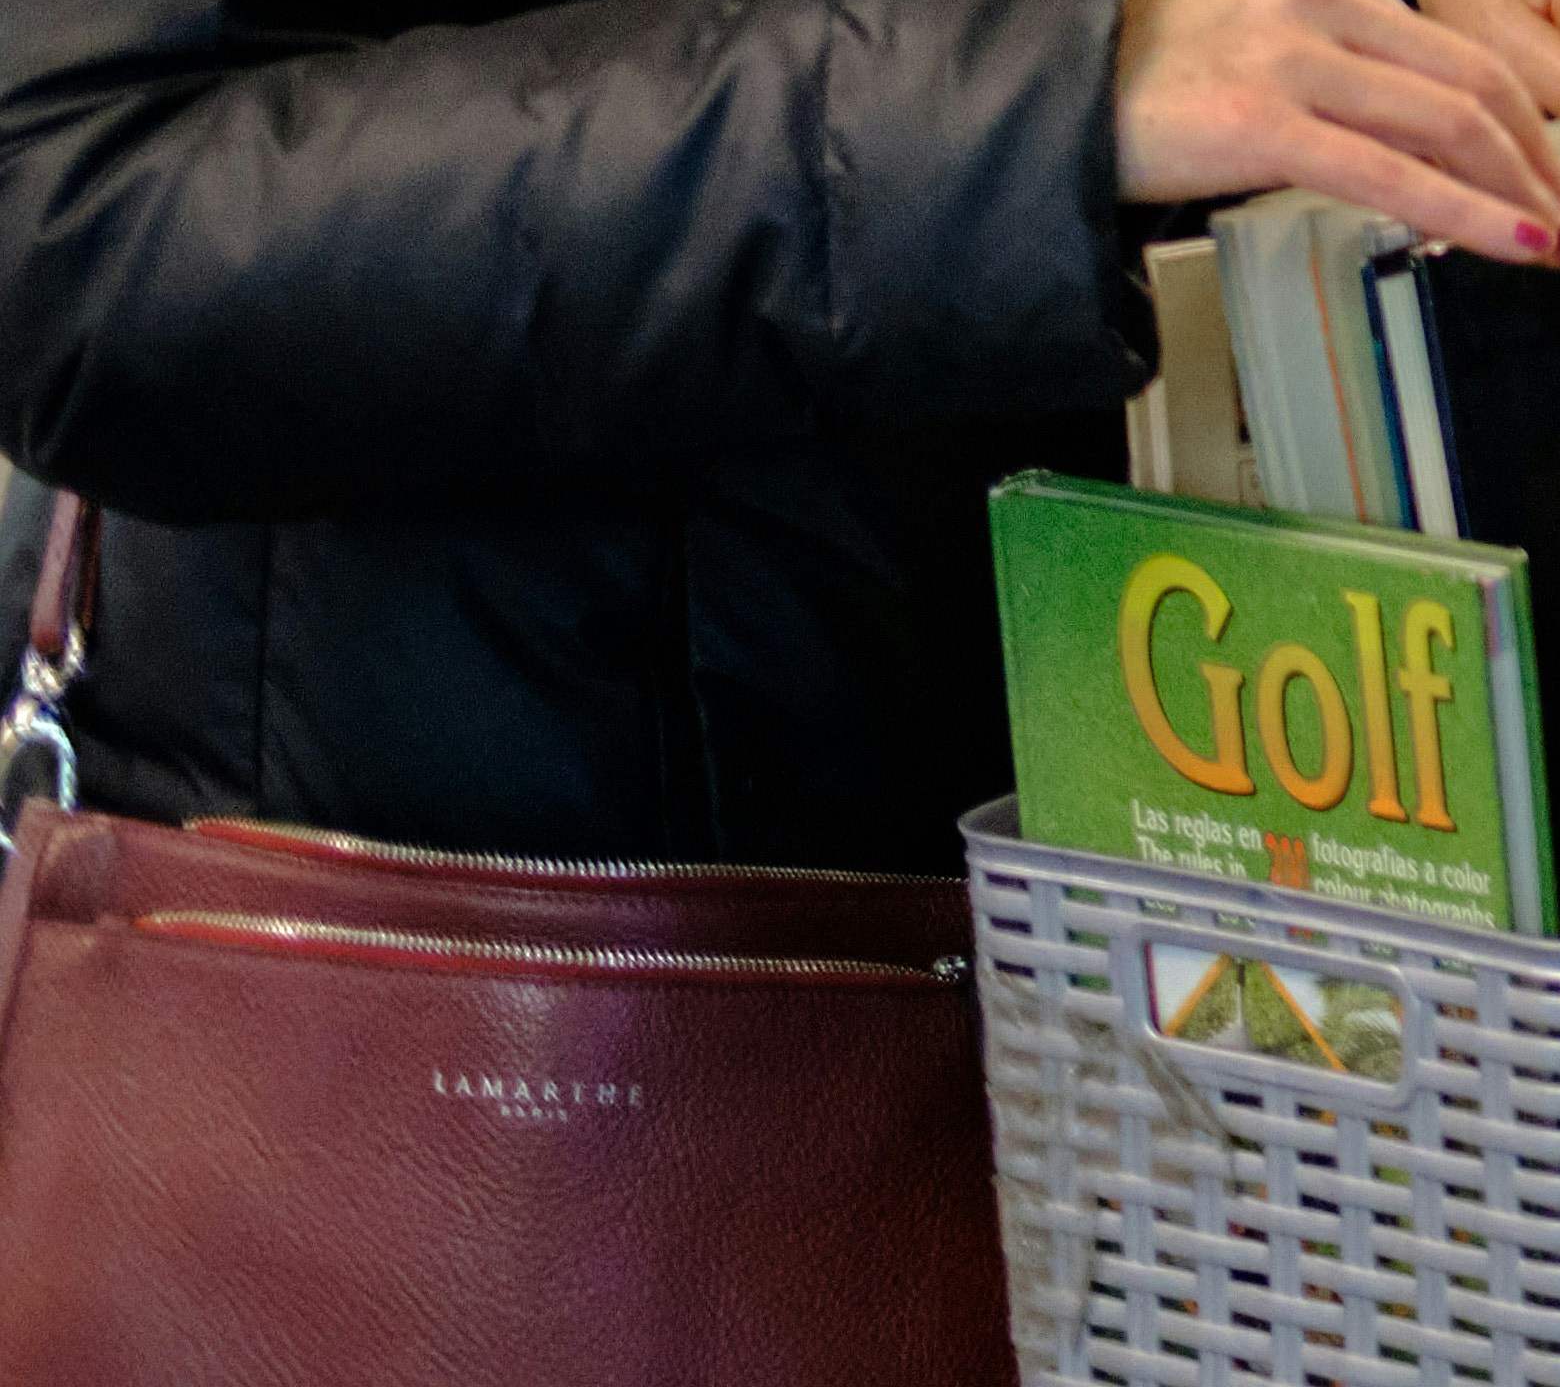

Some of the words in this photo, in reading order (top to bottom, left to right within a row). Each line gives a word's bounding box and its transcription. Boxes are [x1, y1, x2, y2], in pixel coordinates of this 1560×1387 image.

[1117, 552, 1458, 833] Golf
[1132, 798, 1170, 834] Las
[1174, 810, 1234, 849] reglas
[1237, 826, 1263, 851] en
[1424, 861, 1437, 886] a
[1441, 861, 1492, 896] color
[1136, 834, 1173, 864] The
[1226, 851, 1247, 878] in
